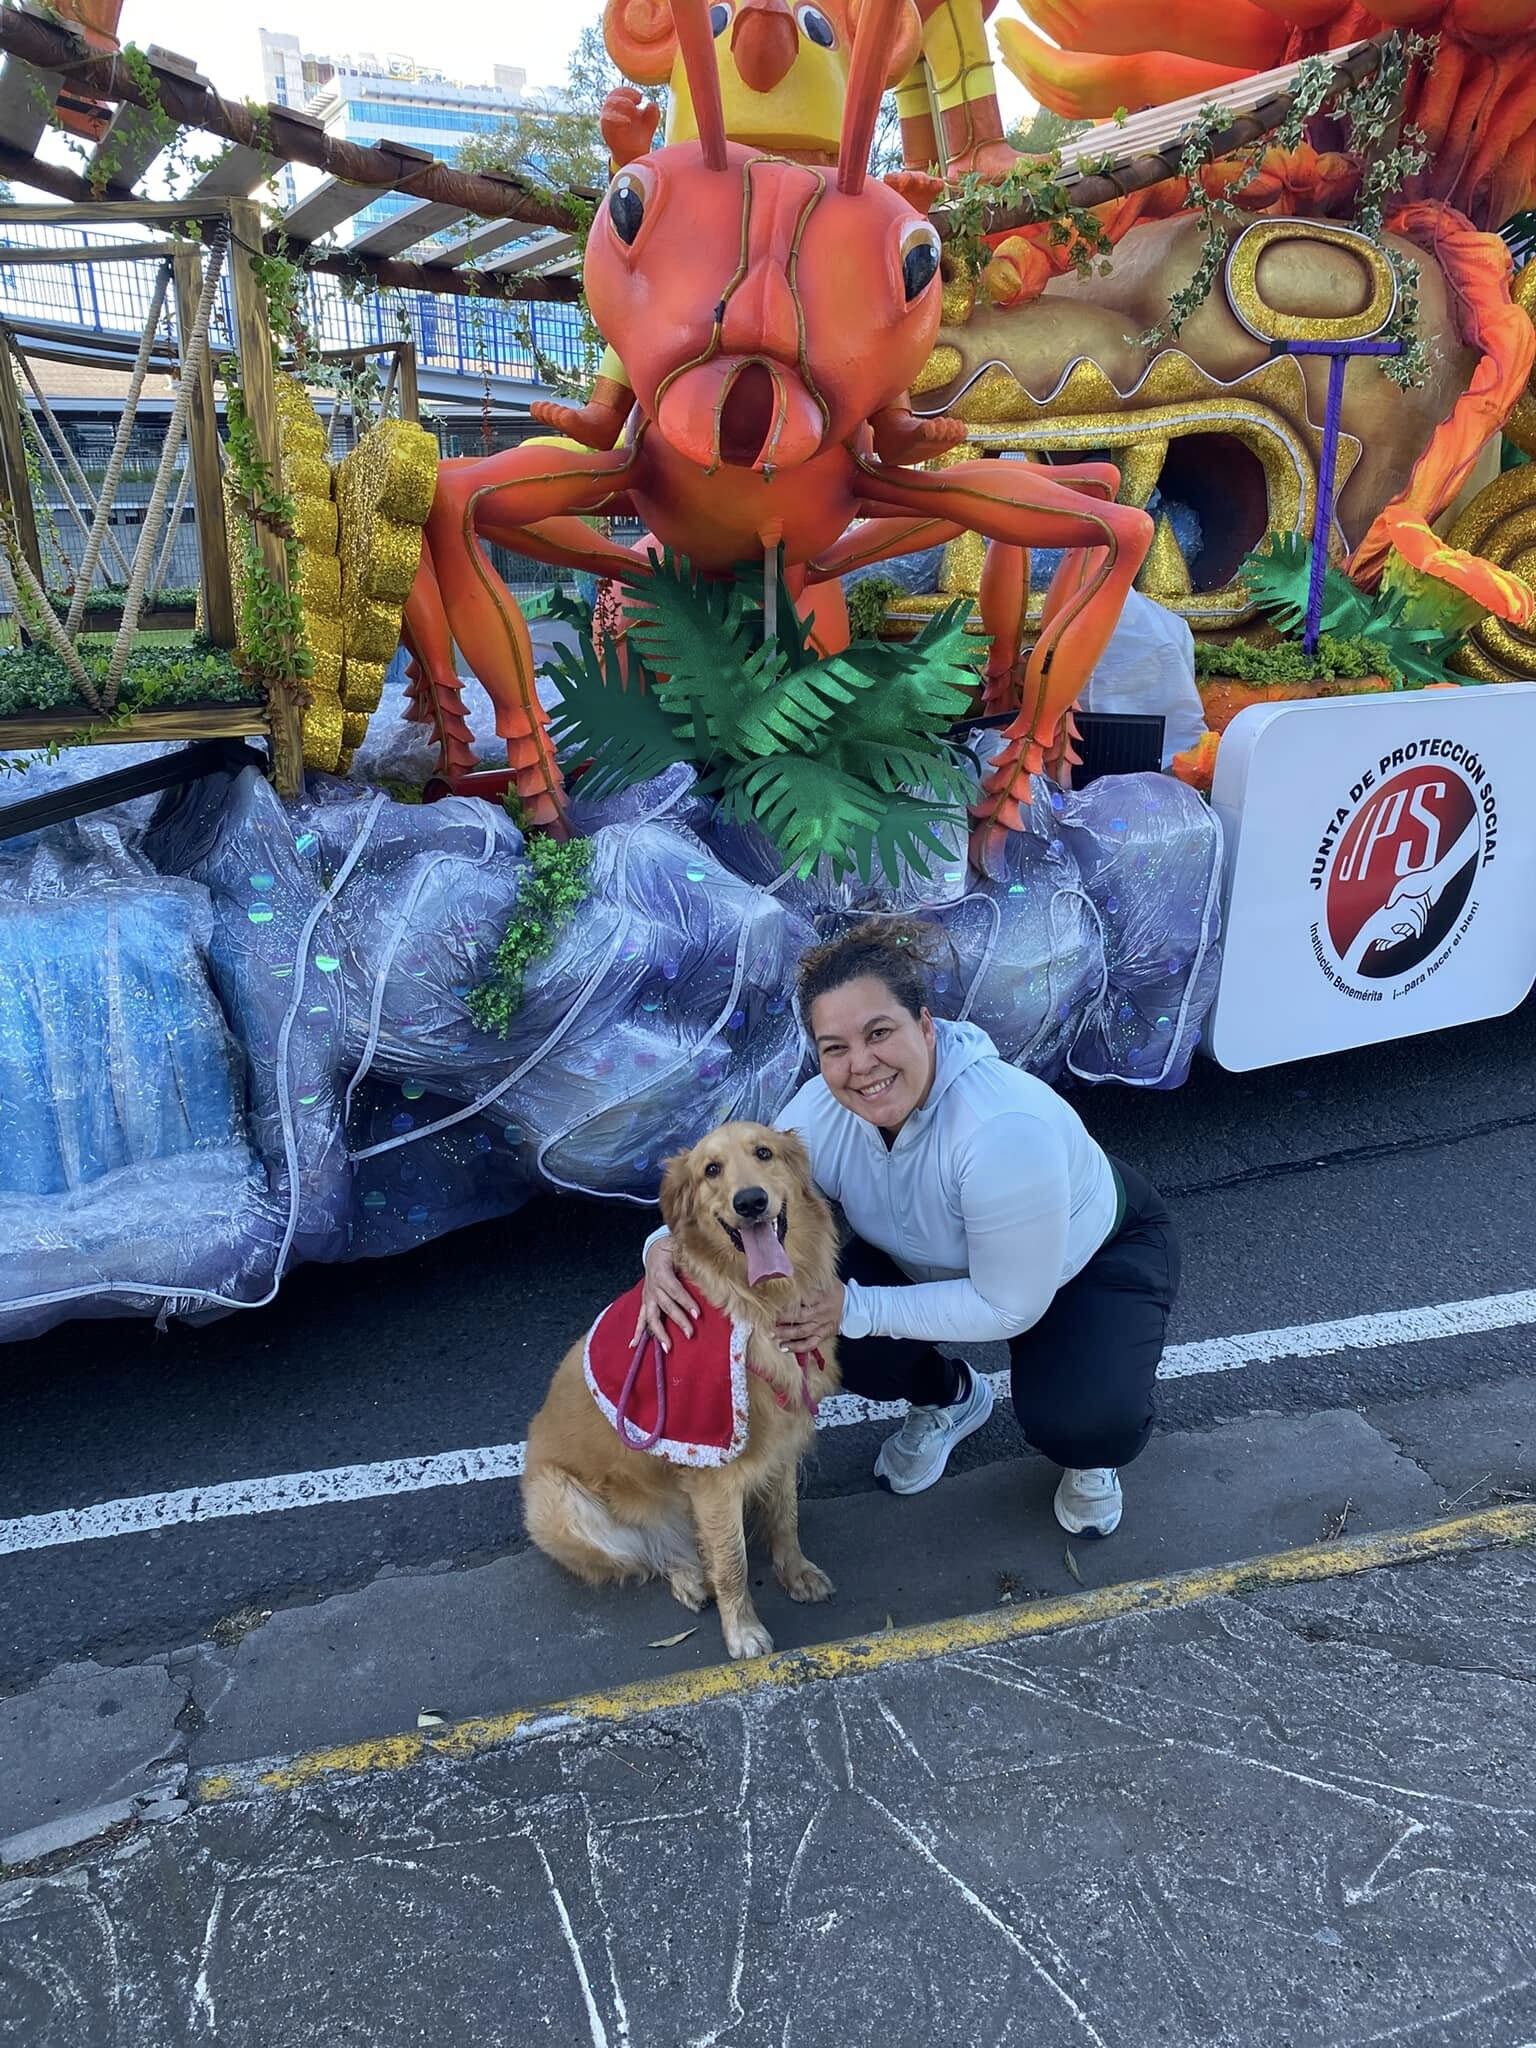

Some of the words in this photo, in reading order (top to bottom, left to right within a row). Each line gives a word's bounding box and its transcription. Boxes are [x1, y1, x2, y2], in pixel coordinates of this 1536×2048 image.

[1310, 808, 1350, 890] JUNTA
[1349, 769, 1375, 804] DE
[1379, 738, 1486, 785] PROTECCIÓN
[1480, 783, 1498, 868] SOCIAL
[1310, 922, 1335, 981] Institución
[1333, 976, 1383, 1001] Benemérita
[1426, 946, 1453, 976] hacer
[1452, 934, 1463, 946] el
